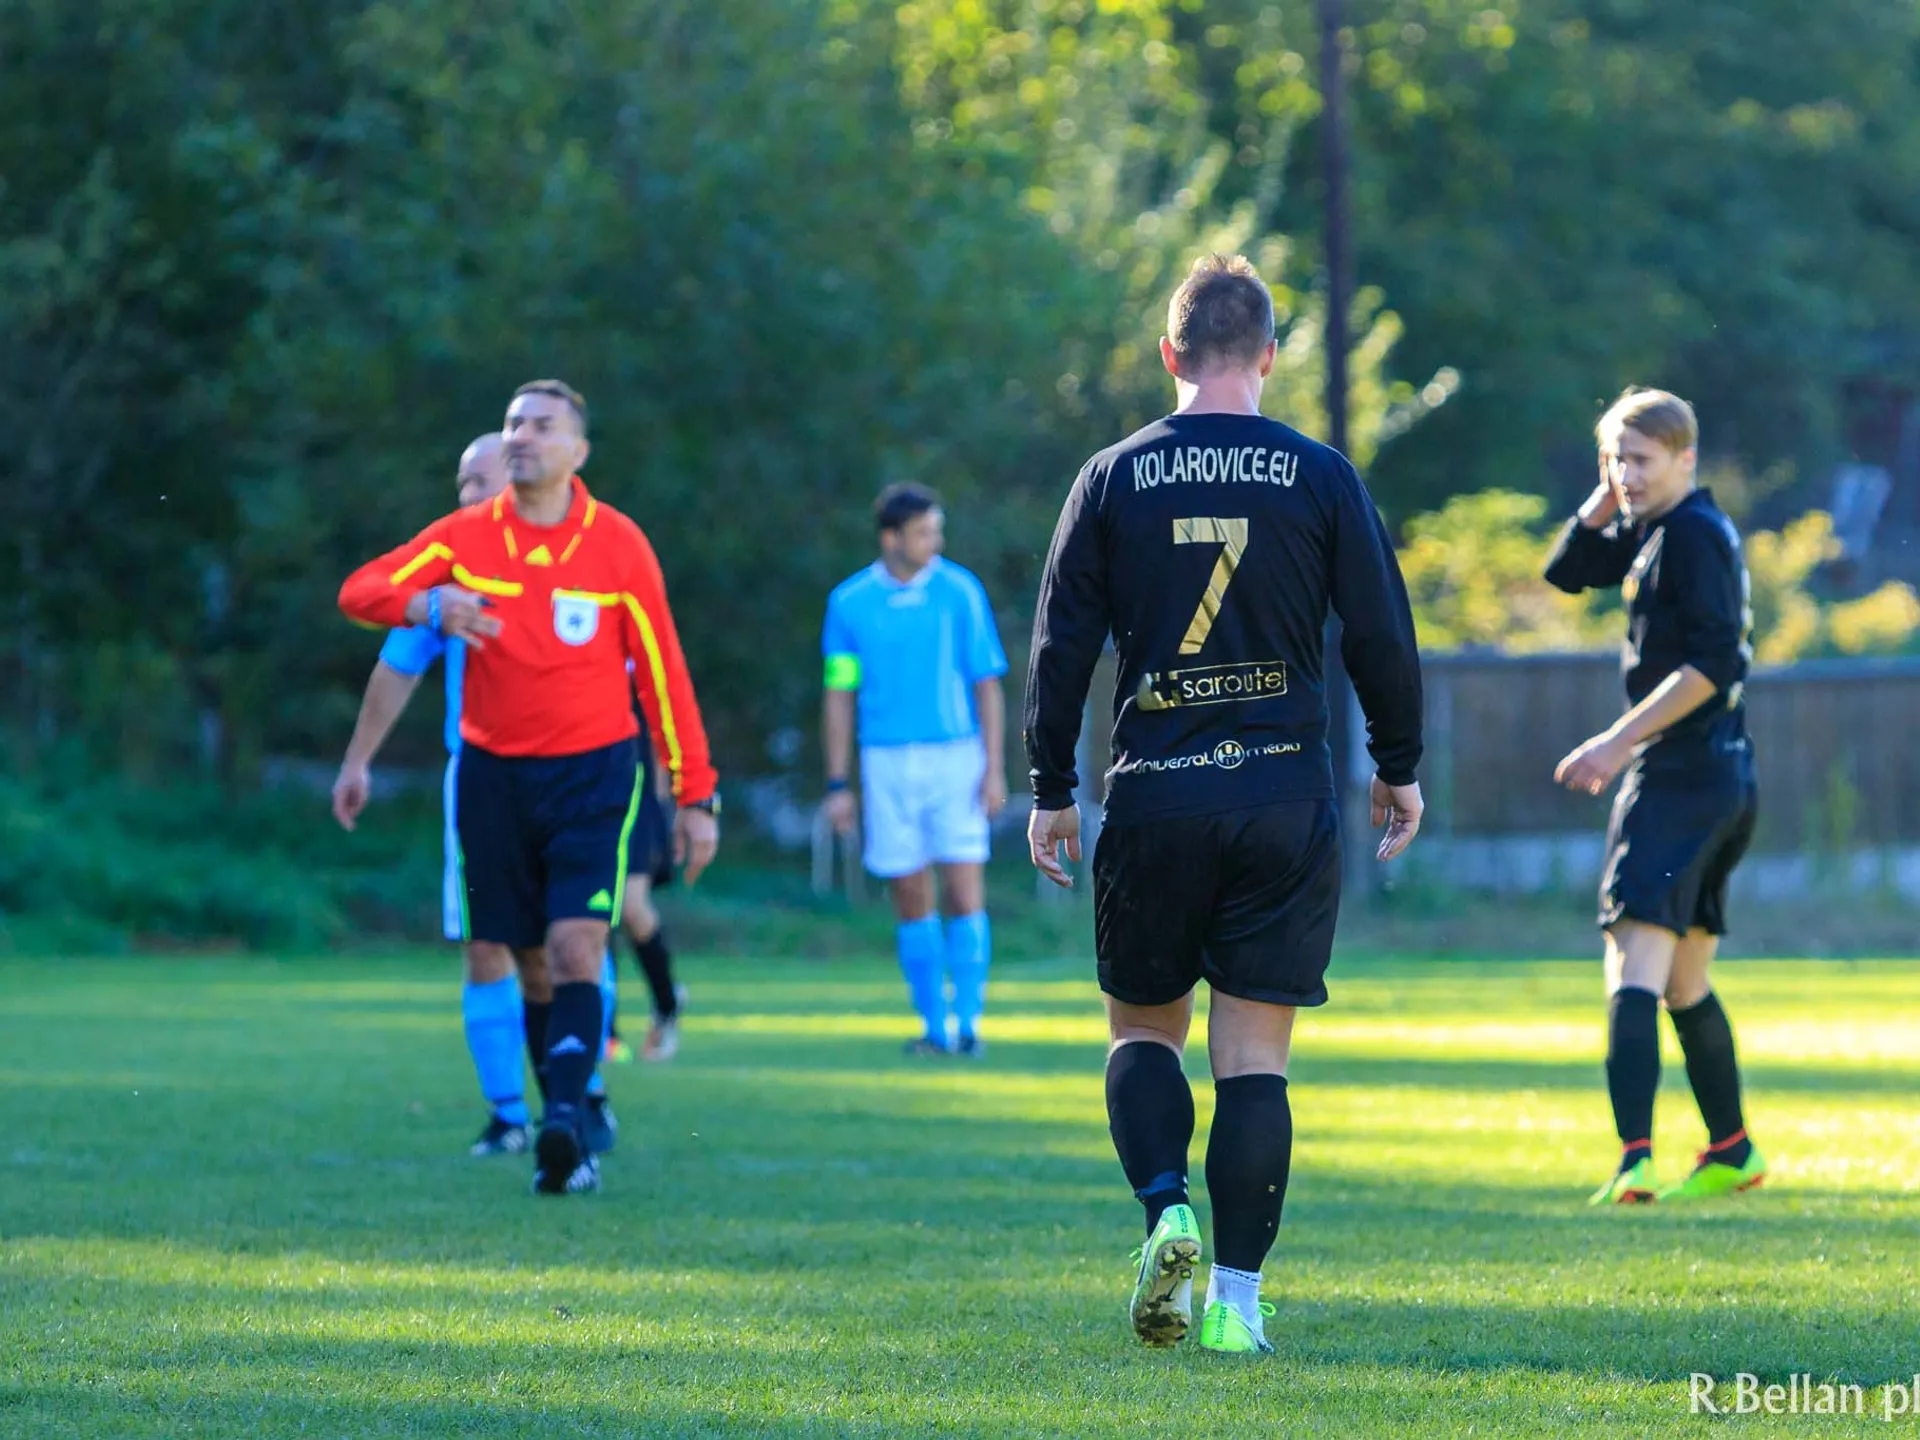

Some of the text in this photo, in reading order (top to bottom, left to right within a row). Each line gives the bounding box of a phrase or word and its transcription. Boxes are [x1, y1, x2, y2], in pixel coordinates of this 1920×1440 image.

[1133, 446, 1298, 491] KOLAROVICE.EU
[1173, 517, 1248, 655] 7
[1182, 667, 1282, 699] saroute
